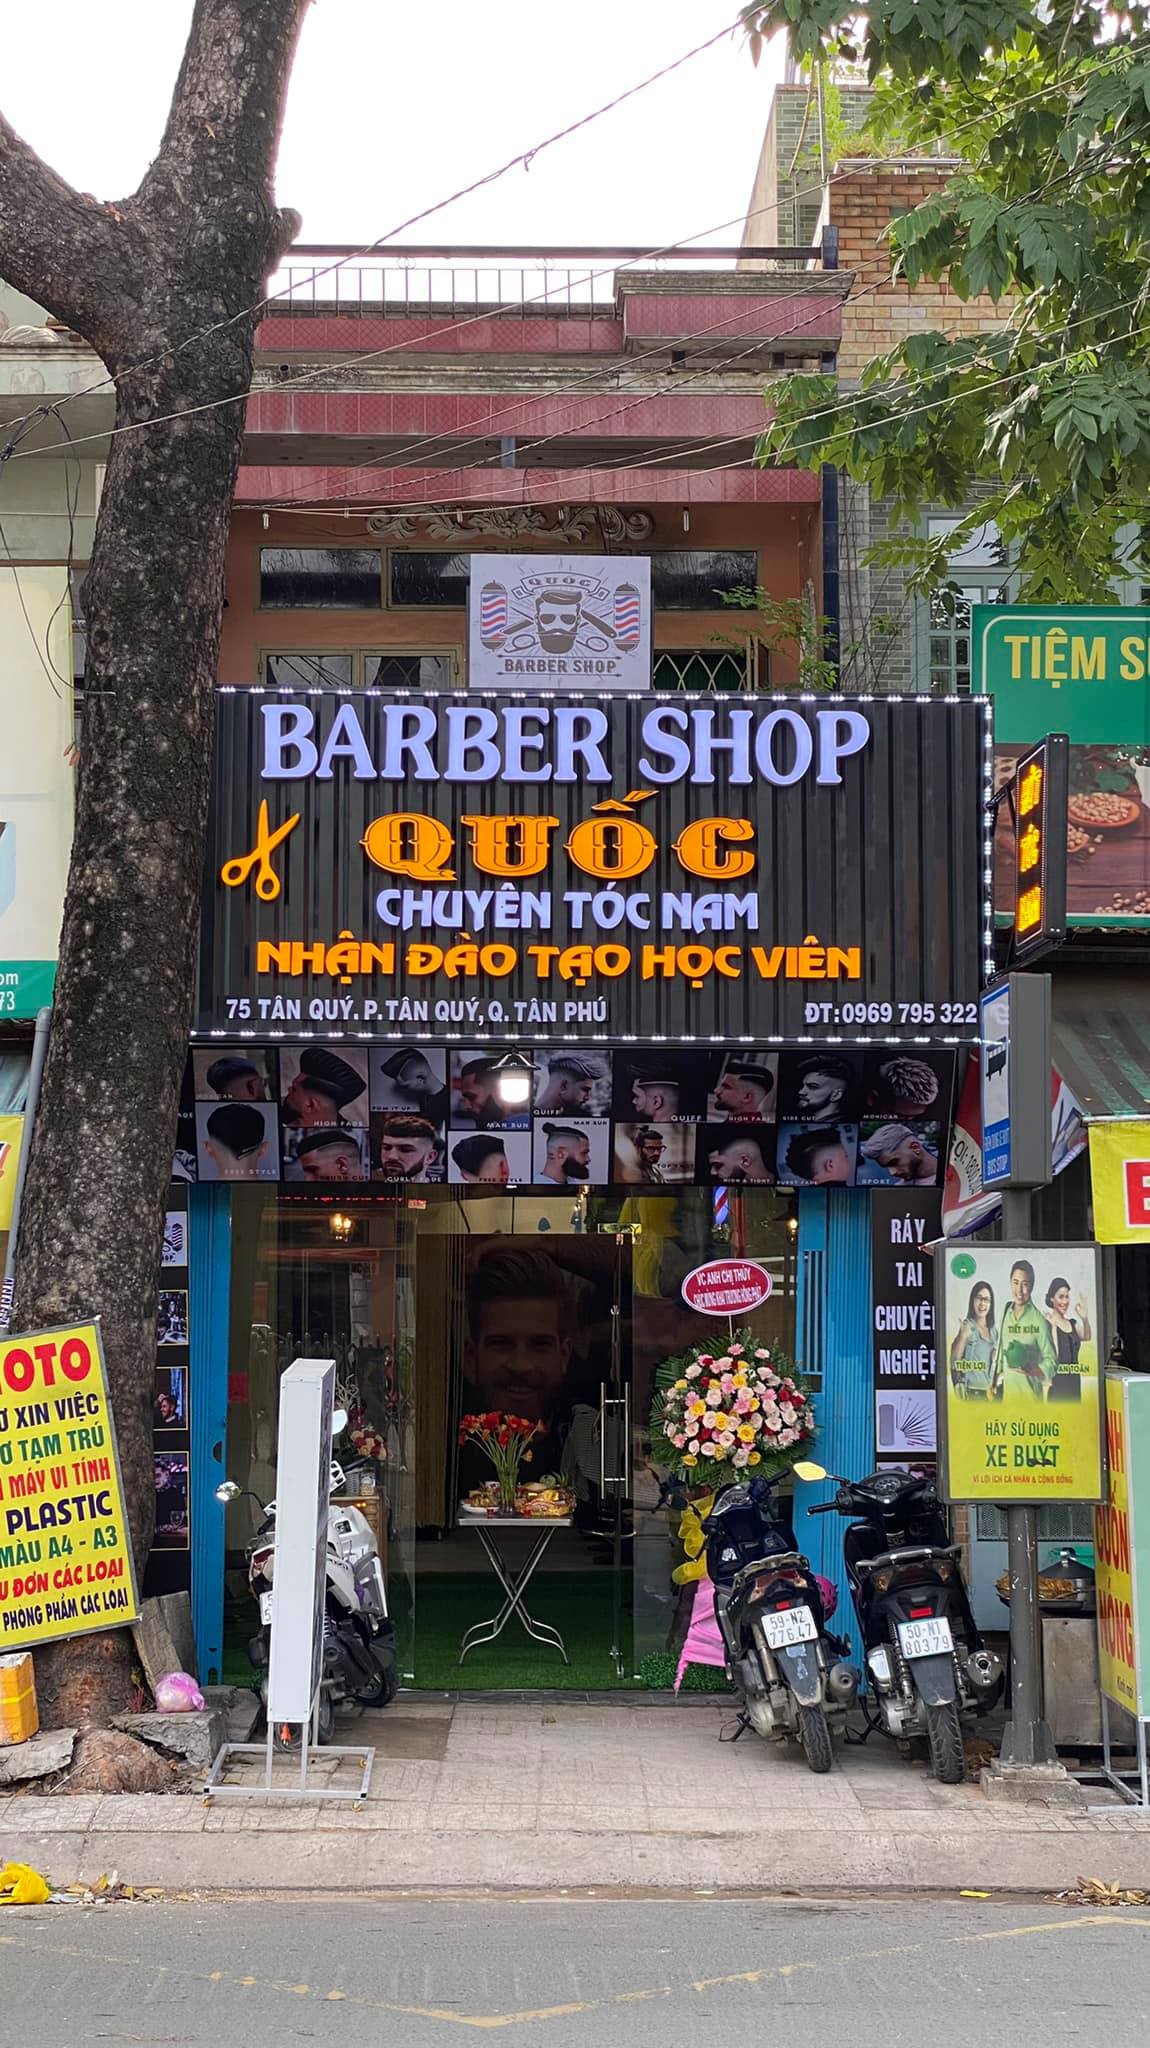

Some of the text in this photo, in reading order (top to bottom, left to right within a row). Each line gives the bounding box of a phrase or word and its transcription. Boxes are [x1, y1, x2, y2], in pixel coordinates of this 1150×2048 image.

[504, 659, 616, 673] BARBER SHOP
[1004, 627, 1150, 689] TIỆM S
[261, 703, 870, 786] BARBER SHOP
[359, 790, 756, 881] QUỐC
[377, 882, 760, 934] CHUYÊN TÓC NAM
[256, 930, 862, 989] NHẬN ĐÀO TẠO HỌC VIÊN
[226, 999, 250, 1019] 75
[258, 995, 300, 1020] TÂN
[514, 998, 557, 1022] TÂN
[564, 996, 607, 1022] PHÚ
[899, 1004, 935, 1024] 795
[939, 1004, 977, 1024] 322
[890, 1213, 926, 1244] RÁY
[896, 1262, 923, 1287] TAI
[875, 1300, 935, 1331] CHUYÊ
[0, 1337, 91, 1396] OTO
[15, 1402, 50, 1429] XIN
[55, 1391, 99, 1422] VIỆC
[985, 1418, 1060, 1440] HÃY SỬ DỤNG
[18, 1433, 62, 1464] TẠM
[66, 1421, 105, 1452] TRÚ
[986, 1440, 1060, 1468] XE BUÝT
[8, 1467, 45, 1498] MÁY
[50, 1466, 68, 1489] VI
[72, 1457, 111, 1486] TÍNH
[6, 1491, 113, 1535] PLASTIC
[0, 1539, 42, 1569] MÀU
[48, 1535, 73, 1559] A4
[93, 1525, 118, 1550] A3
[13, 1570, 49, 1598] ĐƠN
[53, 1562, 83, 1589] CÁC
[86, 1557, 124, 1584] LOẠI
[3, 1604, 43, 1631] PHÒNG
[81, 1591, 101, 1615] CÁC
[103, 1588, 129, 1612] LOẠI
[770, 1611, 806, 1631] 59-N2
[907, 1621, 941, 1639] 50-N1
